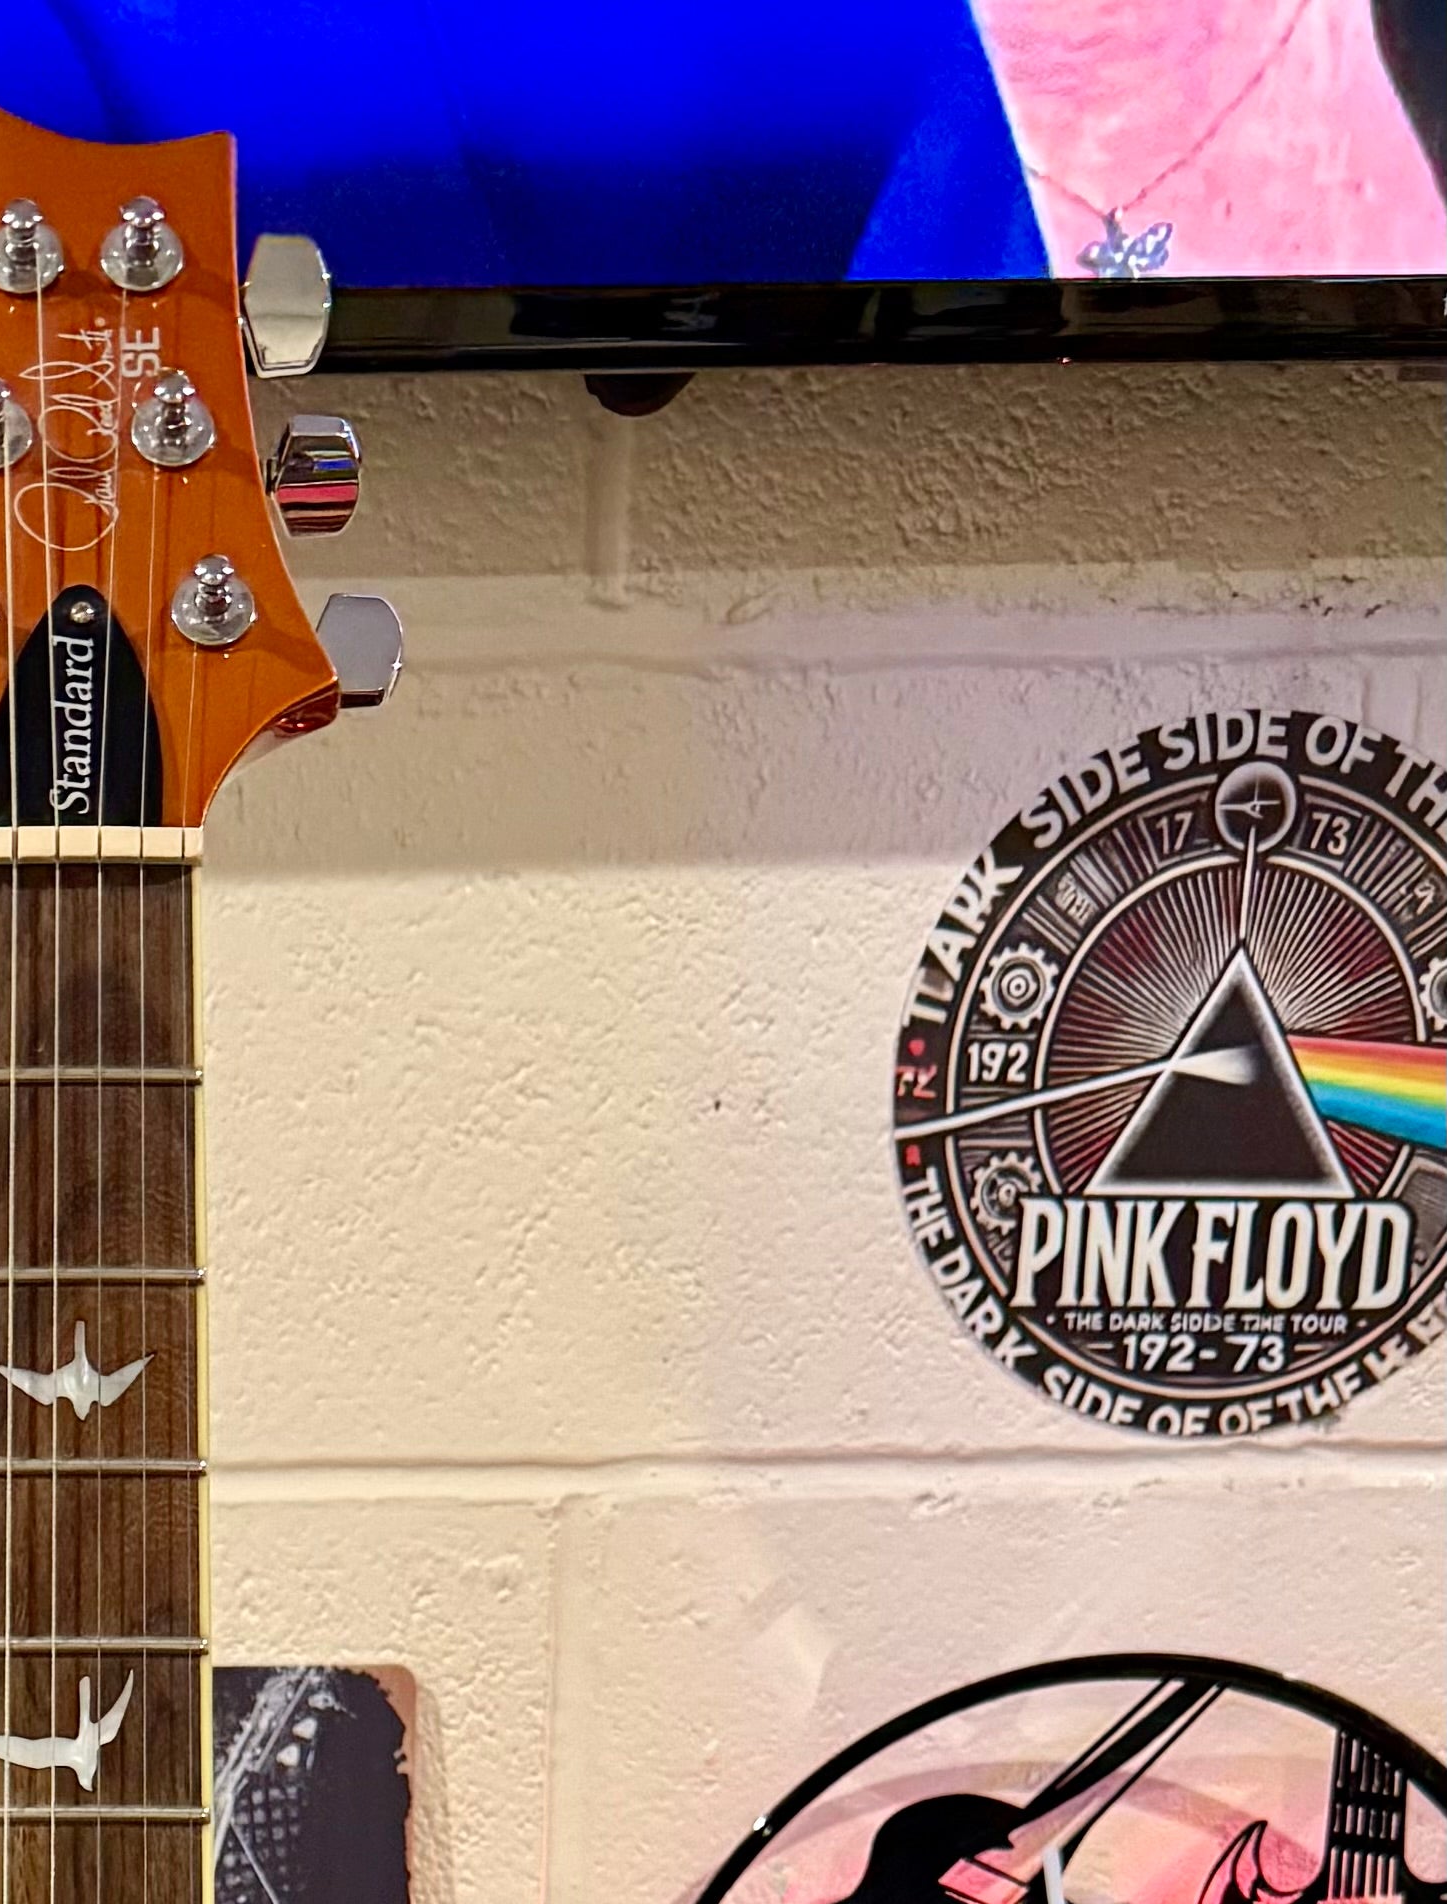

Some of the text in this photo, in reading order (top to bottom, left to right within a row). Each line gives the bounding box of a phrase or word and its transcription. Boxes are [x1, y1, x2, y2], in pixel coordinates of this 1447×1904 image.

[120, 326, 161, 378] SE
[49, 635, 95, 815] Standard
[1019, 738, 1151, 849] SIDE
[1158, 709, 1292, 771] SIDE
[1305, 714, 1383, 774] OF
[1384, 741, 1447, 843] TH
[1310, 812, 1352, 857] 73
[967, 1042, 1030, 1084] 192
[900, 1167, 956, 1249] THE
[930, 1245, 1039, 1371] DARK
[1008, 1199, 1412, 1311] PINK FLOYD
[1064, 1311, 1104, 1334] THE
[1109, 1312, 1166, 1334] DARK
[1289, 1311, 1349, 1336] TOUR
